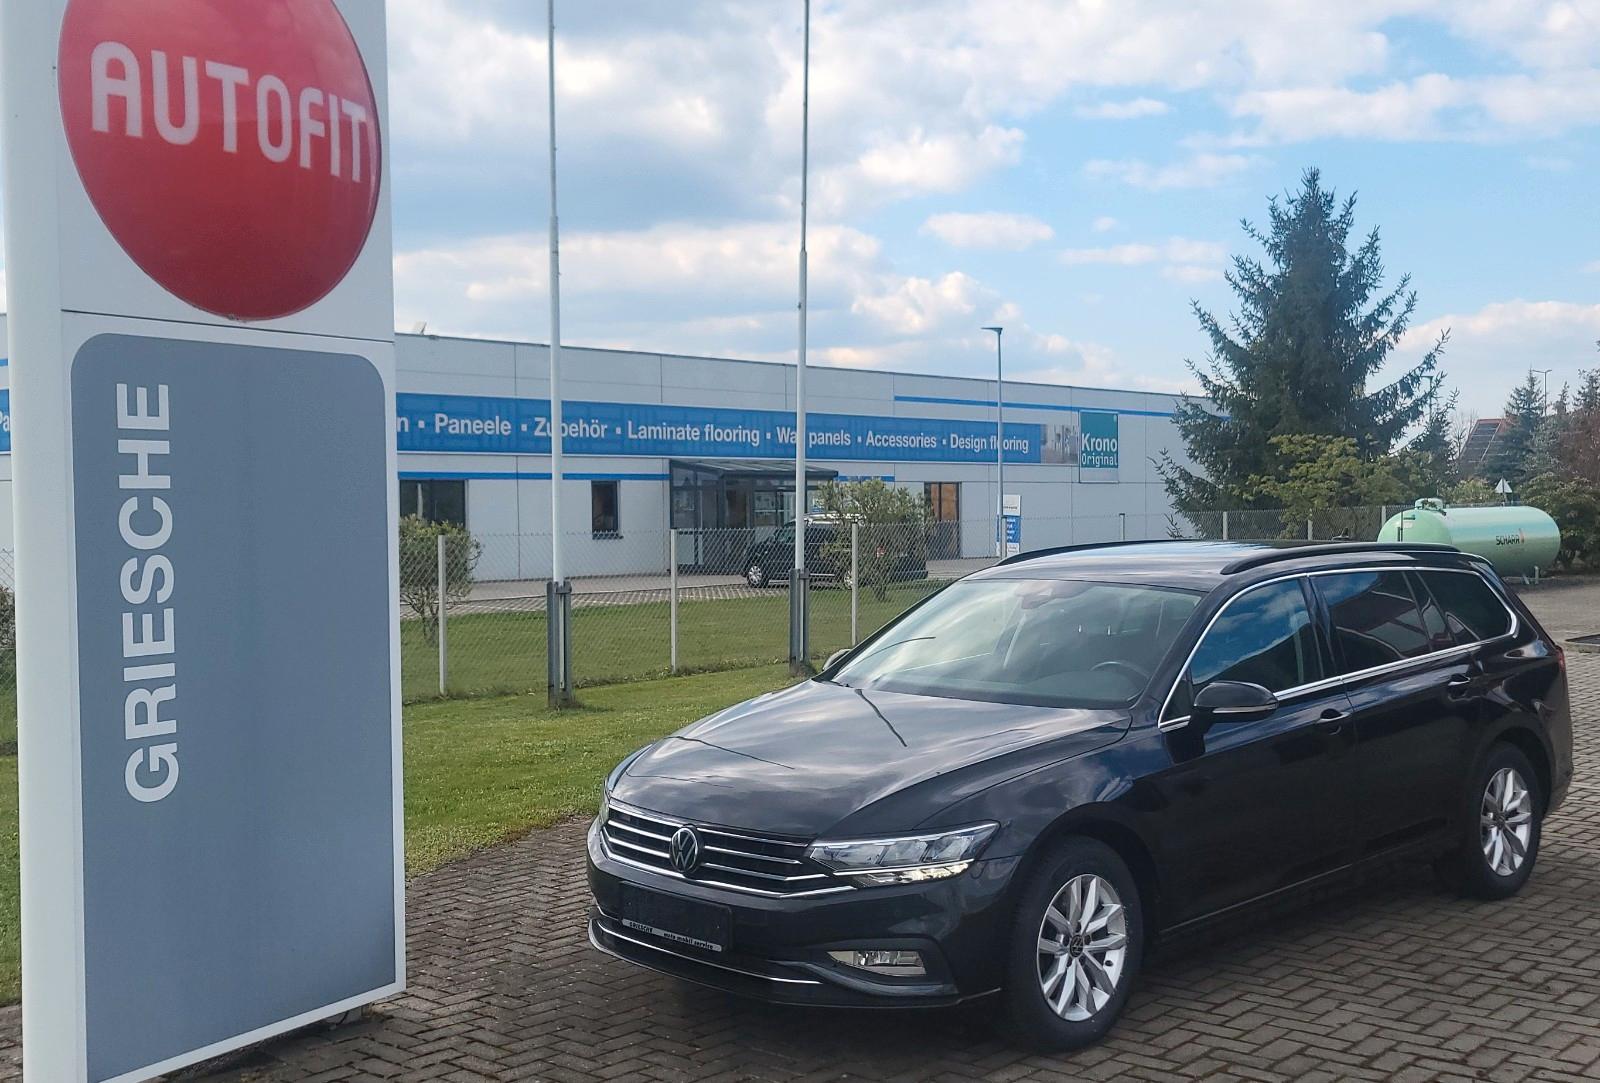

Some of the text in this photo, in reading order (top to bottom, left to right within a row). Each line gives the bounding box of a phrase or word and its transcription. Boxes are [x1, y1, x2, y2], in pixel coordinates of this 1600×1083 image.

[91, 41, 368, 183] AUTOFIT
[434, 412, 512, 436] Paneele
[627, 420, 701, 441] Laminate
[704, 424, 760, 447] flooring
[776, 426, 799, 444] Wa
[809, 429, 851, 448] panels
[866, 431, 937, 449] Accessories
[950, 433, 987, 453] Design
[1081, 432, 1118, 452] Krono
[1081, 452, 1118, 468] Original
[116, 383, 180, 803] GRIESCHE
